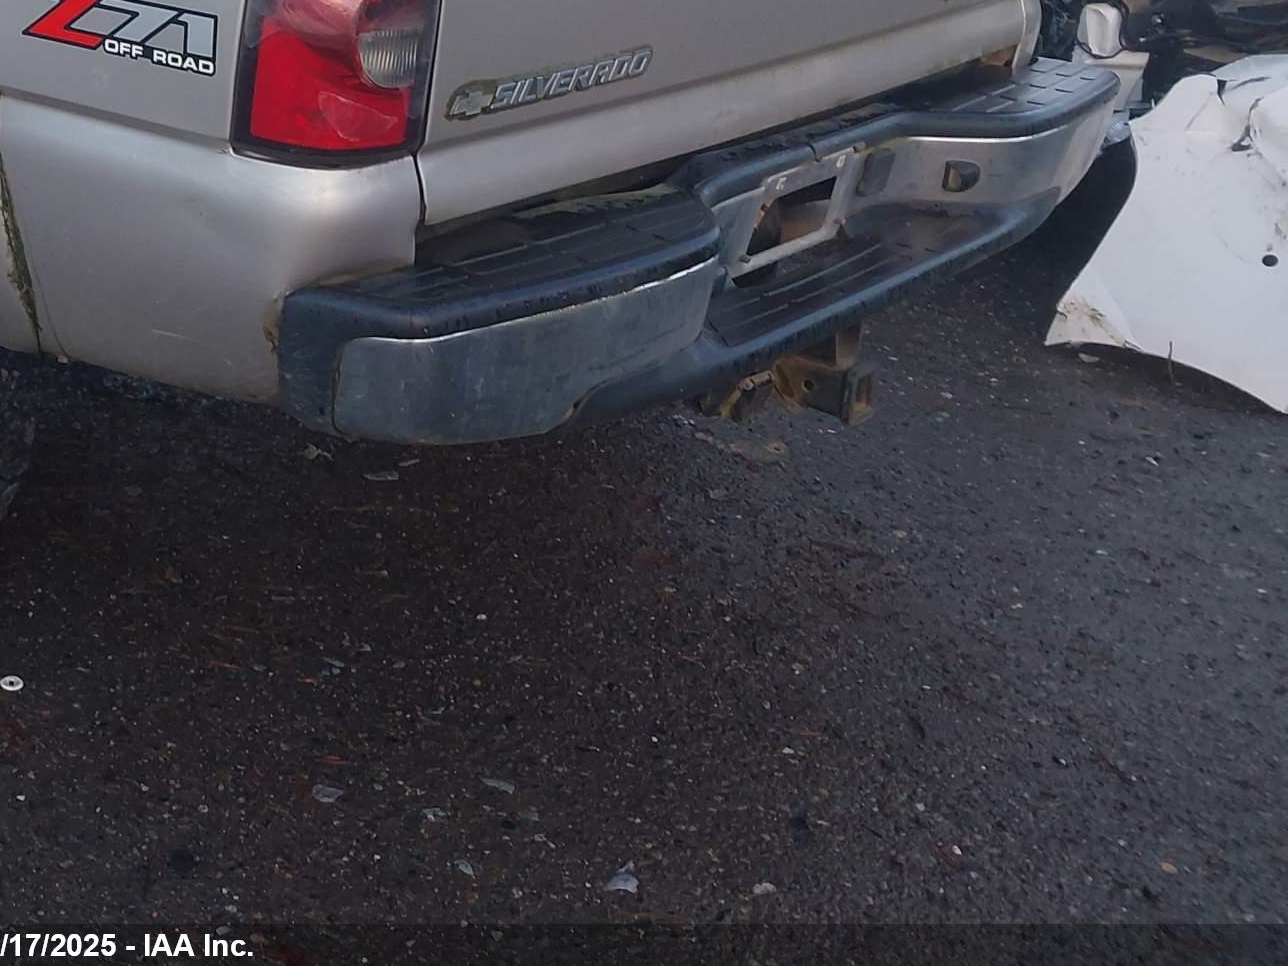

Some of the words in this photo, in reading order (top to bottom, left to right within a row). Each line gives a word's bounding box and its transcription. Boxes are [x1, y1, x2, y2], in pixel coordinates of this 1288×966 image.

[103, 38, 144, 59] OFF
[152, 50, 215, 75] ROAD
[490, 48, 652, 110] SILVERADO
